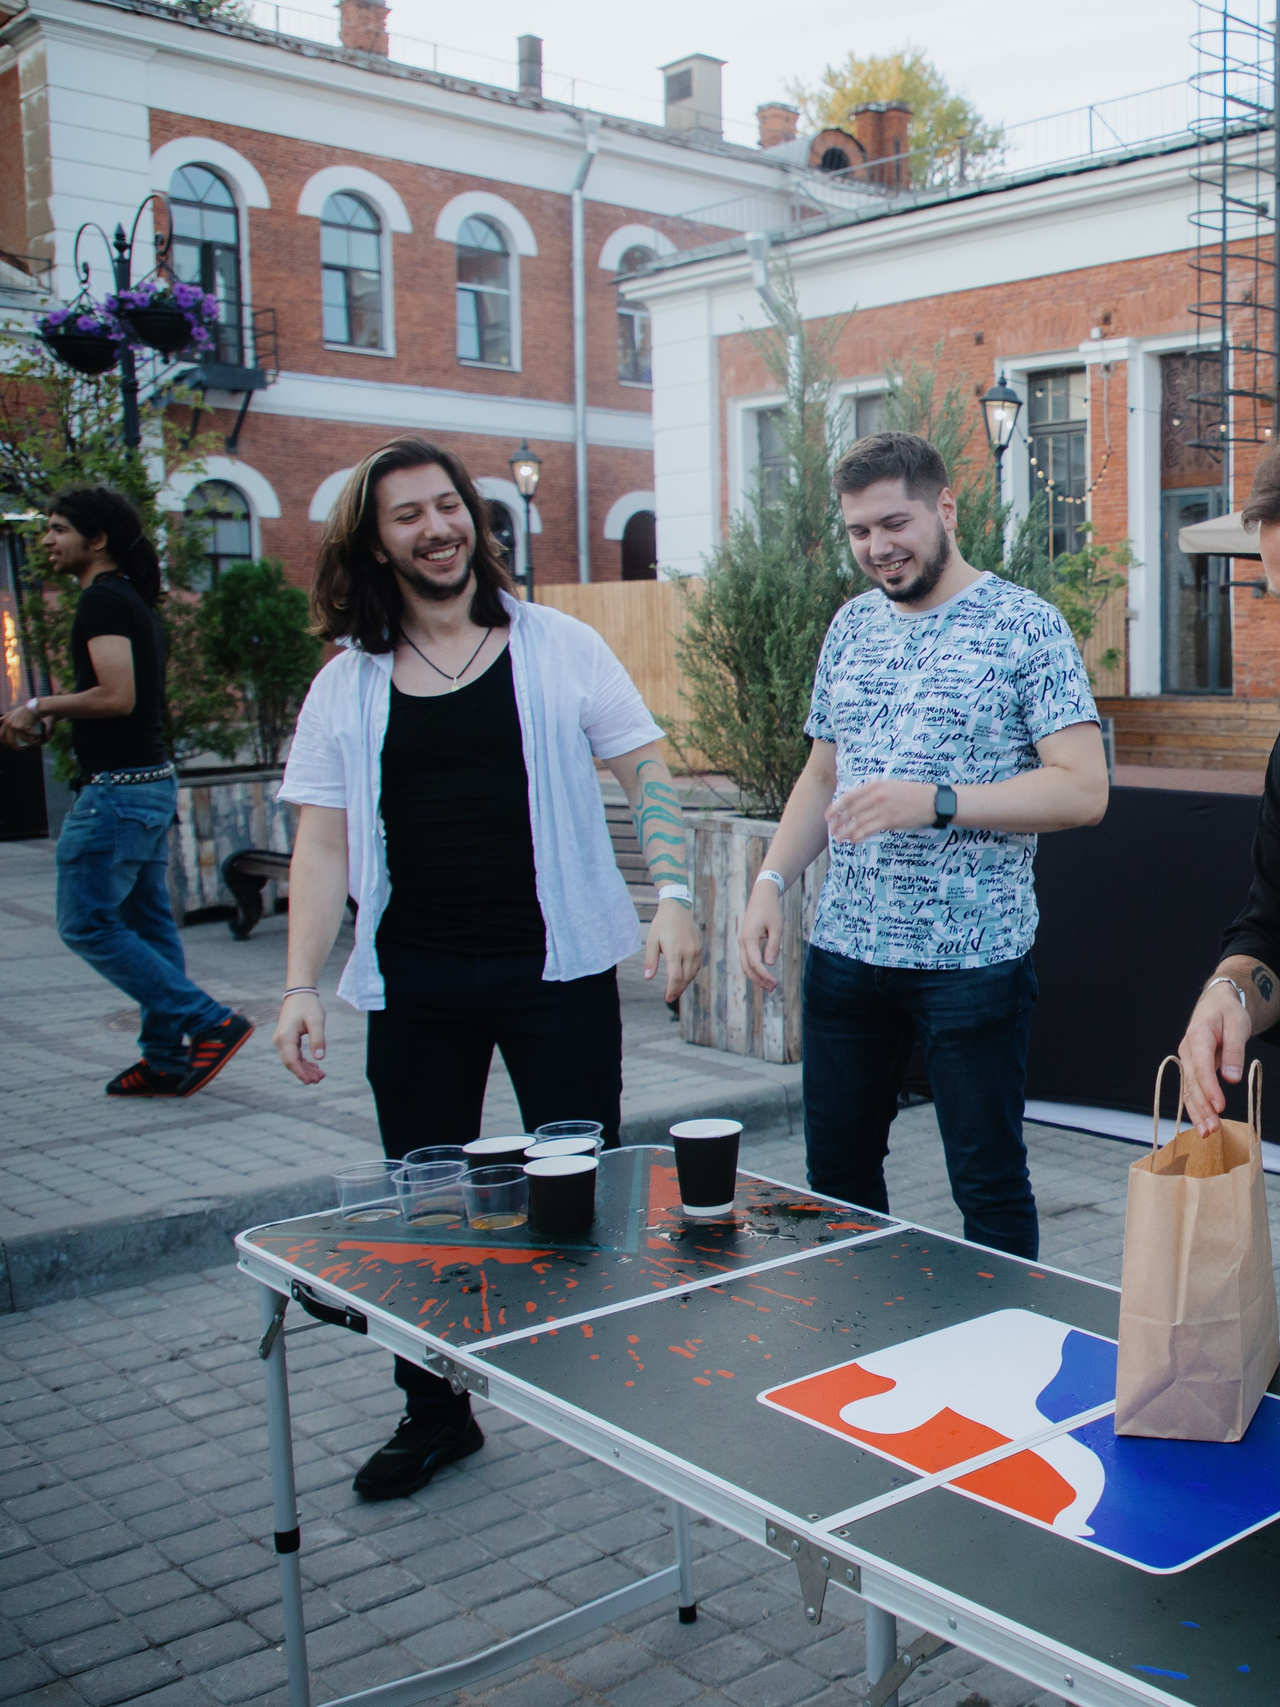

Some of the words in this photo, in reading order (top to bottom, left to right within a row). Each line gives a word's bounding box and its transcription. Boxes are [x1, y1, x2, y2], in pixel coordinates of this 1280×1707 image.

[903, 626, 946, 649] Keep
[886, 647, 938, 671] wild
[933, 732, 975, 750] you
[962, 744, 1005, 770] Keep
[910, 898, 950, 916] you
[941, 906, 988, 929] Keep
[936, 926, 988, 955] wild
